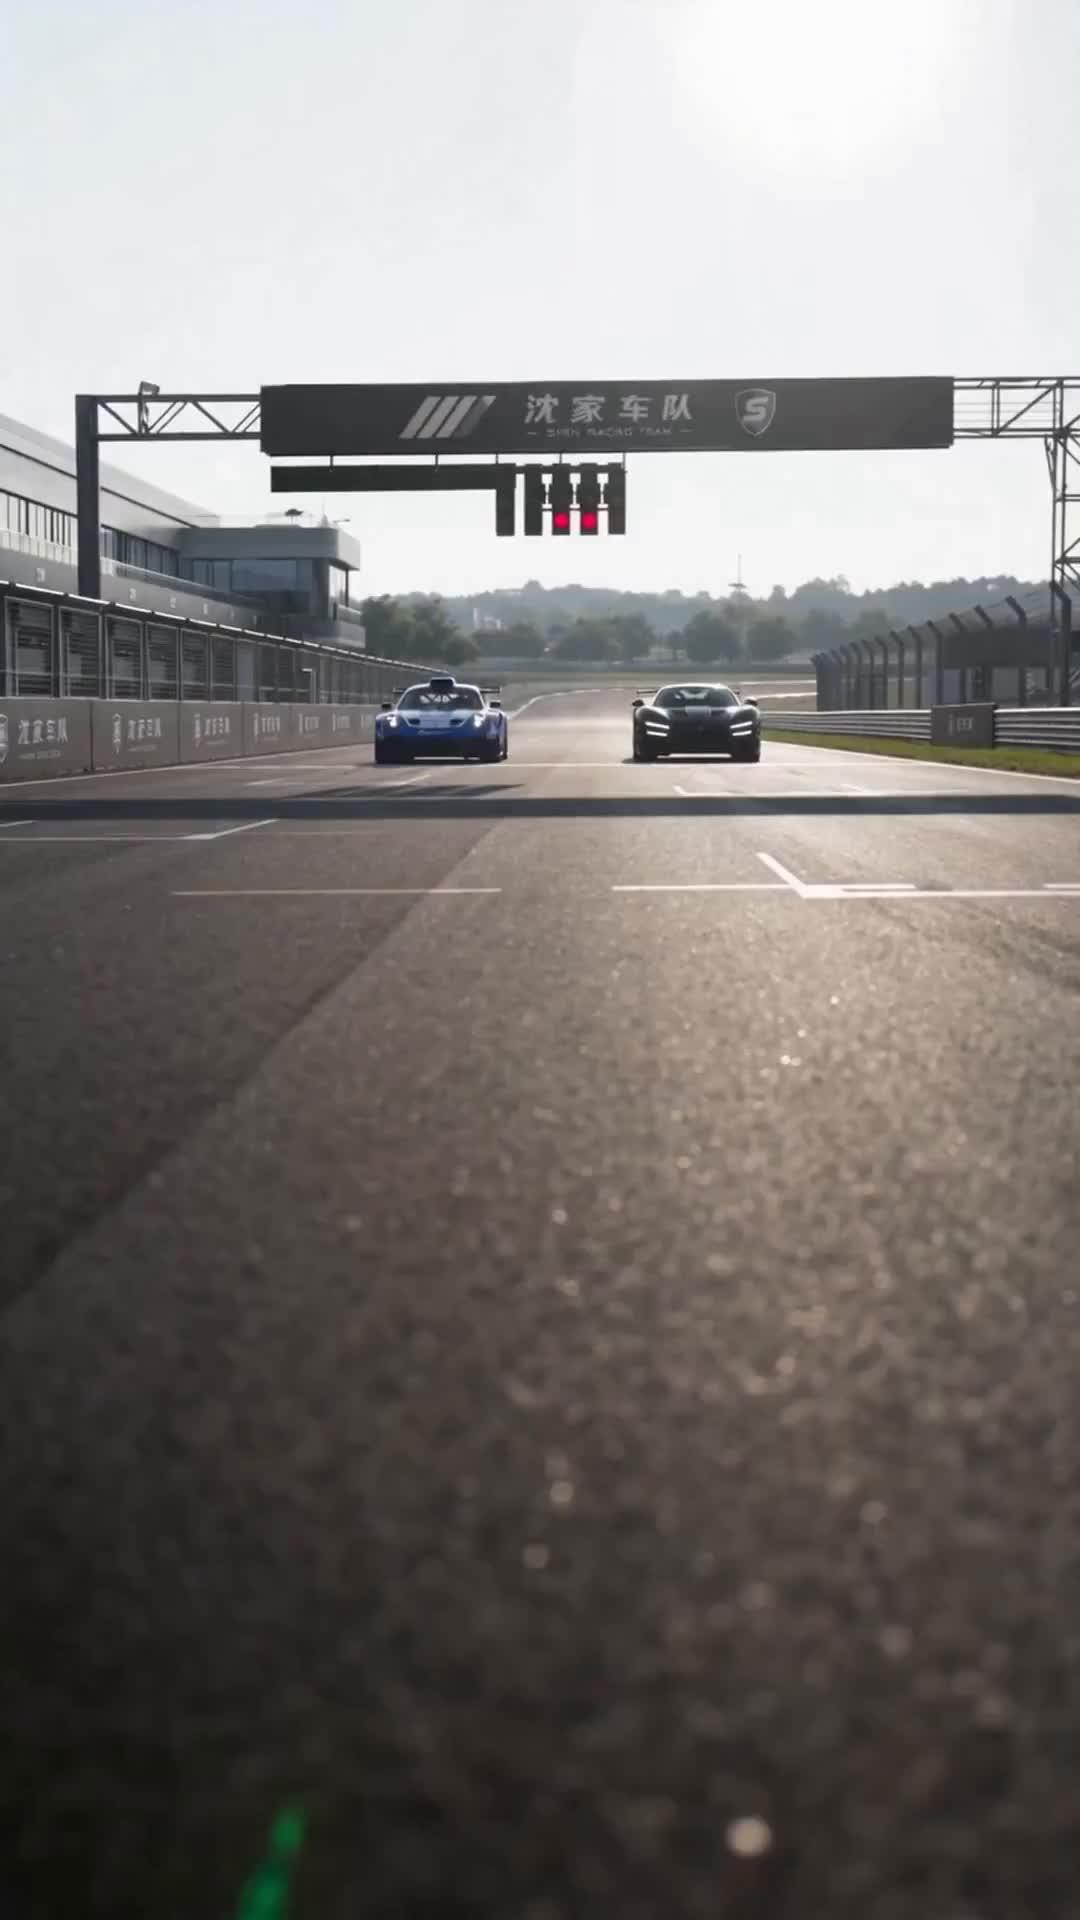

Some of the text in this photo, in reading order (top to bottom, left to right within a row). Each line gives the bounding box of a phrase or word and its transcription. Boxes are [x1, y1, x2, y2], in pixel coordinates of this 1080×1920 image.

[525, 393, 692, 423] 沈家车队
[744, 396, 769, 422] S
